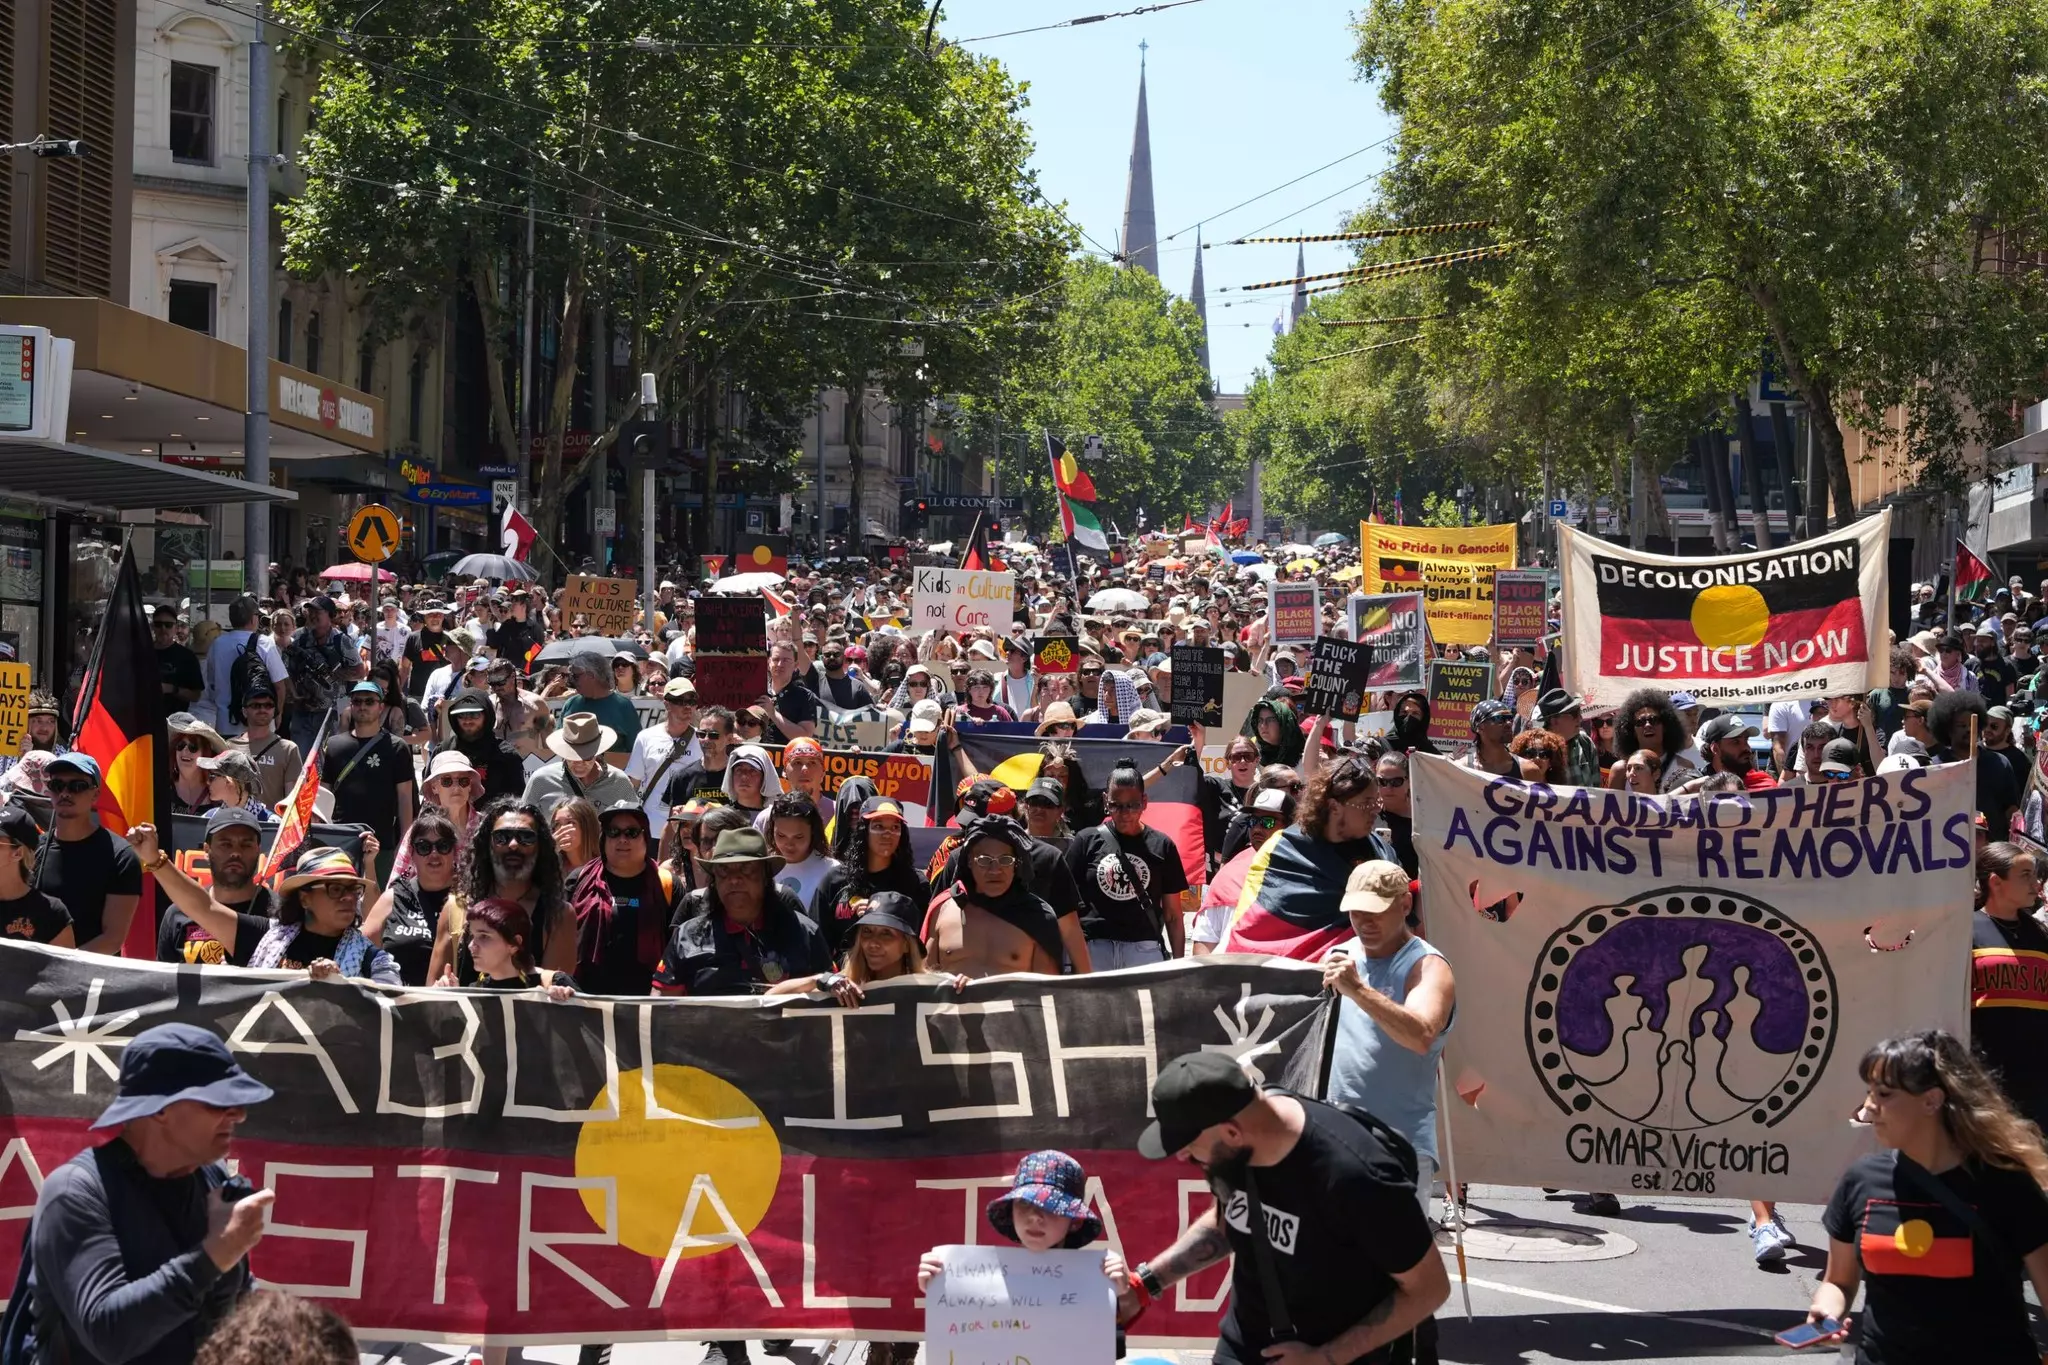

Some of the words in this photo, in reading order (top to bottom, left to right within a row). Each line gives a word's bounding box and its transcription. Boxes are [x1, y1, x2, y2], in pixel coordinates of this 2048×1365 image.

[496, 483, 514, 492] ONE
[1378, 539, 1397, 551] No
[1402, 541, 1437, 554] Pride
[1441, 543, 1454, 554] in
[1458, 542, 1509, 554] Genocide
[1424, 563, 1471, 575] Always
[1600, 547, 1854, 589] DECOLONISATION
[580, 581, 620, 595] KIDS
[917, 570, 951, 594] Kids
[957, 583, 966, 595] in
[968, 575, 1013, 601] Culture
[1500, 584, 1542, 598] STOP
[569, 596, 580, 607] IN
[586, 597, 631, 613] CULTURE
[1277, 593, 1312, 604] STOP
[926, 602, 946, 618] not
[955, 604, 990, 627] Care
[1276, 609, 1312, 619] BLACK
[1500, 605, 1542, 616] BLACK
[569, 612, 595, 626] NT
[596, 613, 630, 632] CARE
[1277, 620, 1312, 628] DEATHS
[1391, 611, 1417, 629] NO
[1500, 617, 1542, 627] DEATHS
[1366, 632, 1401, 646] PRIDE
[1173, 649, 1203, 661] WHITE
[1321, 643, 1358, 663] FUCK
[1616, 643, 1753, 674] JUSTICE
[1762, 627, 1850, 669] NOW
[1315, 658, 1342, 674] THE
[1440, 666, 1482, 676] ALWAYS
[1309, 673, 1349, 694] COLONY
[1448, 678, 1472, 687] WAS
[1437, 691, 1480, 702] ALWAYS
[1437, 702, 1462, 711] WILL
[1430, 718, 1471, 727] ABORIGIN
[1443, 728, 1468, 737] LAND
[1483, 769, 1931, 829] GRANDMOTHERS
[1444, 807, 1673, 877] AGAINST
[1698, 812, 1972, 879] REMOVALS
[226, 988, 1157, 1130] ABOLISH
[1566, 1123, 1667, 1168] GMAR
[1672, 1133, 1789, 1176] Victoria
[1631, 1171, 1664, 1190] est.
[1672, 1169, 1716, 1194] 2018
[1031, 1264, 1063, 1279] WAS
[937, 1293, 998, 1310] ALWAYS
[1011, 1296, 1043, 1308] WILL
[1059, 1293, 1078, 1306] BE
[949, 1319, 1031, 1335] ABORIGINAL
